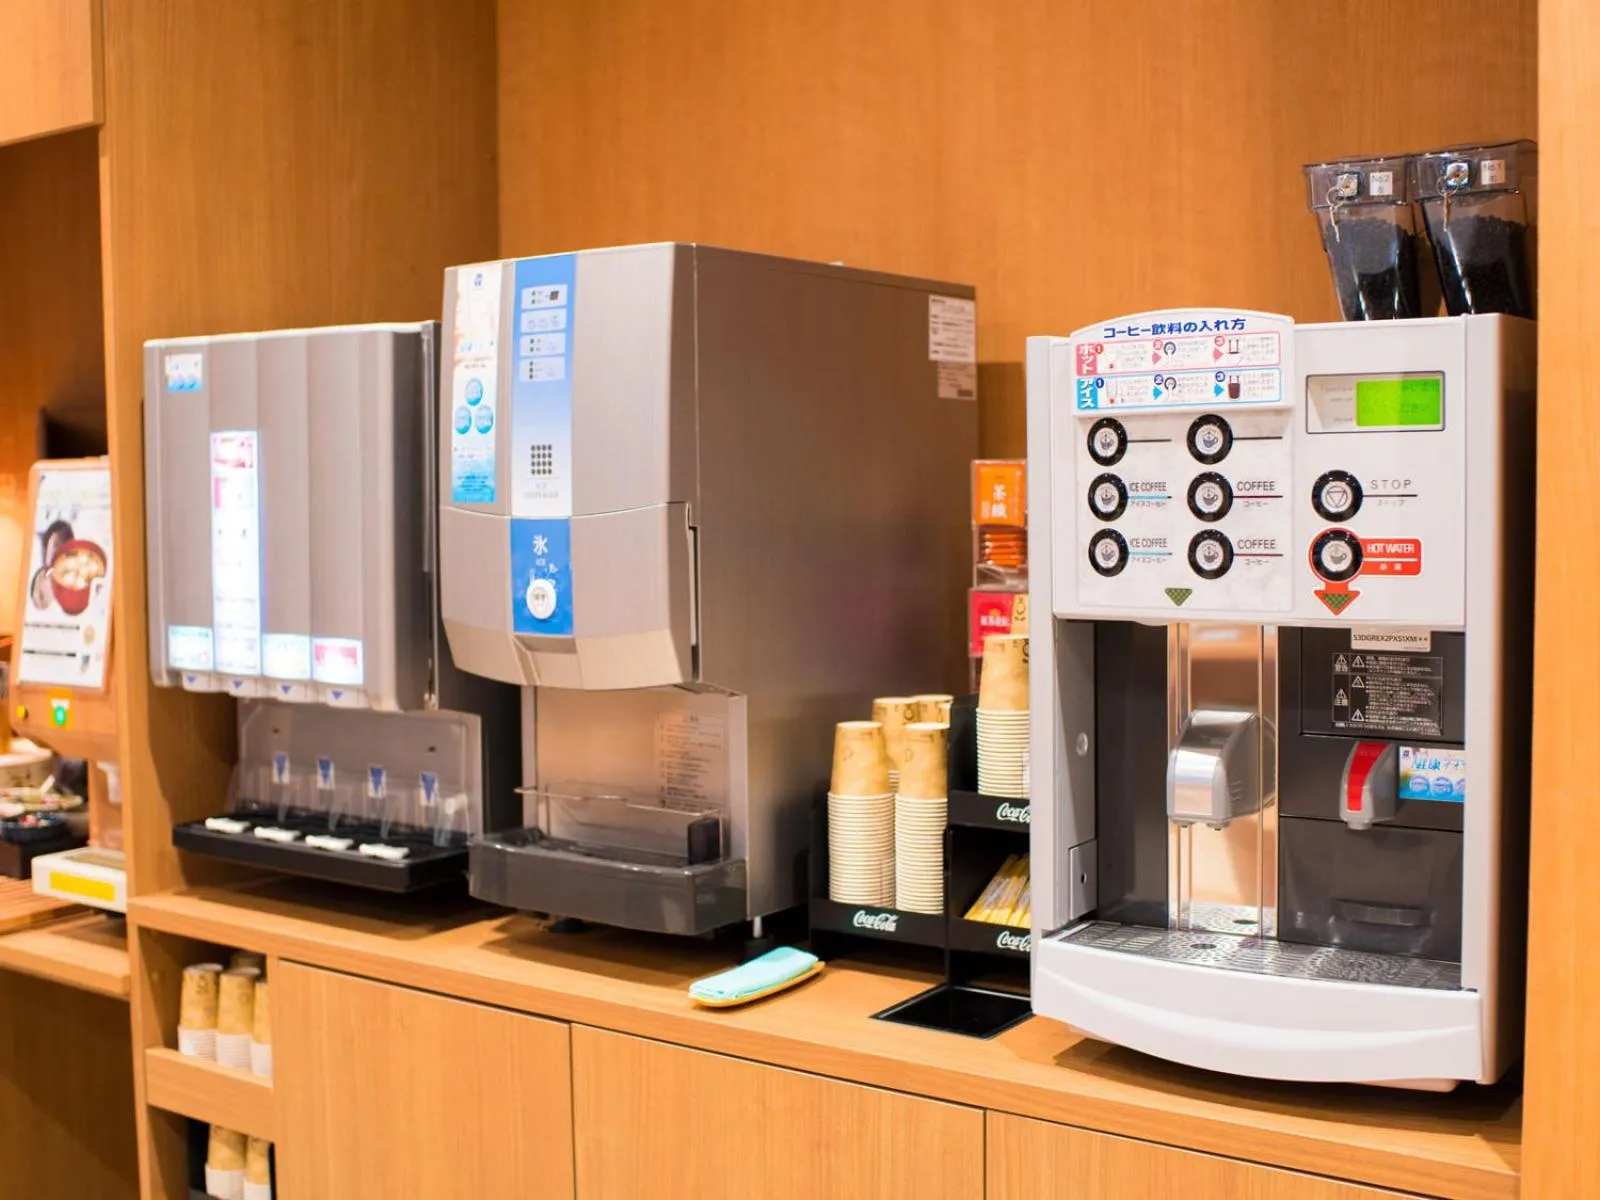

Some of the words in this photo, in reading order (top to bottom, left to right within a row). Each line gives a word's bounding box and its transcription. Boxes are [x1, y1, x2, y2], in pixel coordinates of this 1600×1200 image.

[1103, 319, 1246, 339] コーヒー飲料の入れ方
[1080, 344, 1095, 375] ホット
[1081, 379, 1095, 409] アイス
[1141, 481, 1166, 491] COFFEE
[1237, 481, 1275, 491] COFFEE
[1370, 479, 1411, 490] STOP
[532, 534, 548, 555] 氷
[1141, 537, 1167, 548] COFFEE
[1237, 539, 1276, 550] COFFEE
[1367, 543, 1384, 553] HOT
[1385, 543, 1415, 554] WATER
[853, 909, 899, 932] Coca-Cola
